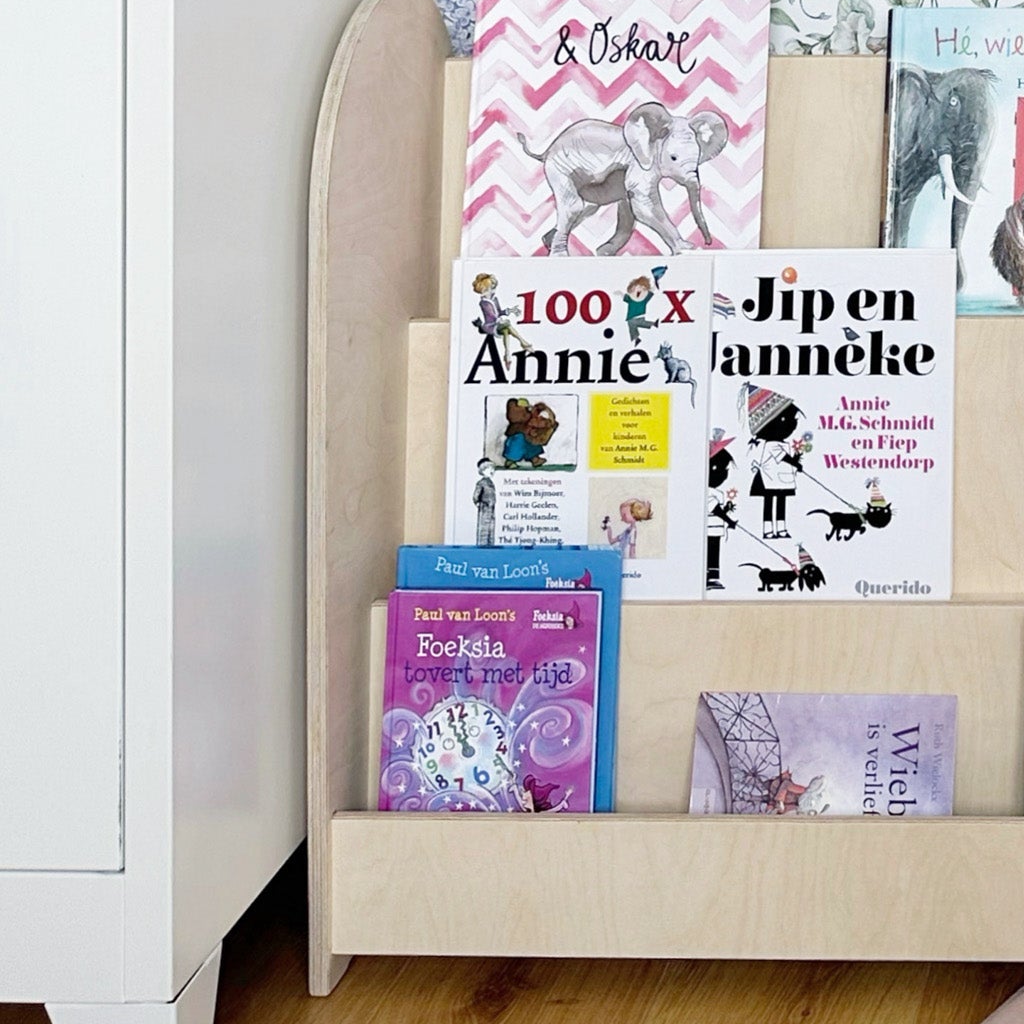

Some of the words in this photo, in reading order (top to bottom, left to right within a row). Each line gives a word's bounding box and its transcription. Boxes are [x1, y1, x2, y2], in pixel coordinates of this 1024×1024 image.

[554, 26, 578, 65] &
[589, 16, 697, 74] Oskar
[935, 26, 978, 58] Hé,
[516, 290, 612, 324] 100
[741, 274, 835, 334] Jip
[846, 289, 919, 322] en
[464, 327, 650, 385] Annie
[836, 396, 891, 411] Annie
[620, 408, 652, 417] verhalen
[859, 415, 935, 431] Schmidt
[615, 443, 637, 452] Annie
[851, 439, 874, 450] en
[877, 435, 918, 454] Fiep
[613, 455, 645, 464] Schmidt
[823, 454, 935, 473] Westendorp
[434, 556, 467, 576] Paul
[472, 566, 499, 579] van
[503, 559, 550, 580] Loon's
[854, 579, 932, 596] Querido
[414, 607, 443, 622] Paul
[446, 611, 471, 622] van
[474, 607, 516, 622] Loon's
[416, 633, 506, 659] Foeksia
[404, 661, 474, 684] tovert
[482, 662, 525, 684] met
[533, 662, 573, 689] tijd
[447, 702, 468, 722] 12
[472, 703, 479, 716] 1
[483, 710, 495, 725] 2
[427, 721, 440, 739] 11
[493, 725, 505, 739] 3
[867, 724, 886, 739] is
[418, 743, 435, 758] 10
[496, 741, 508, 755] 4
[426, 759, 438, 774] 9
[886, 723, 920, 816] Wieb
[435, 774, 449, 789] 8
[473, 766, 490, 785] 6
[454, 777, 464, 792] 7
